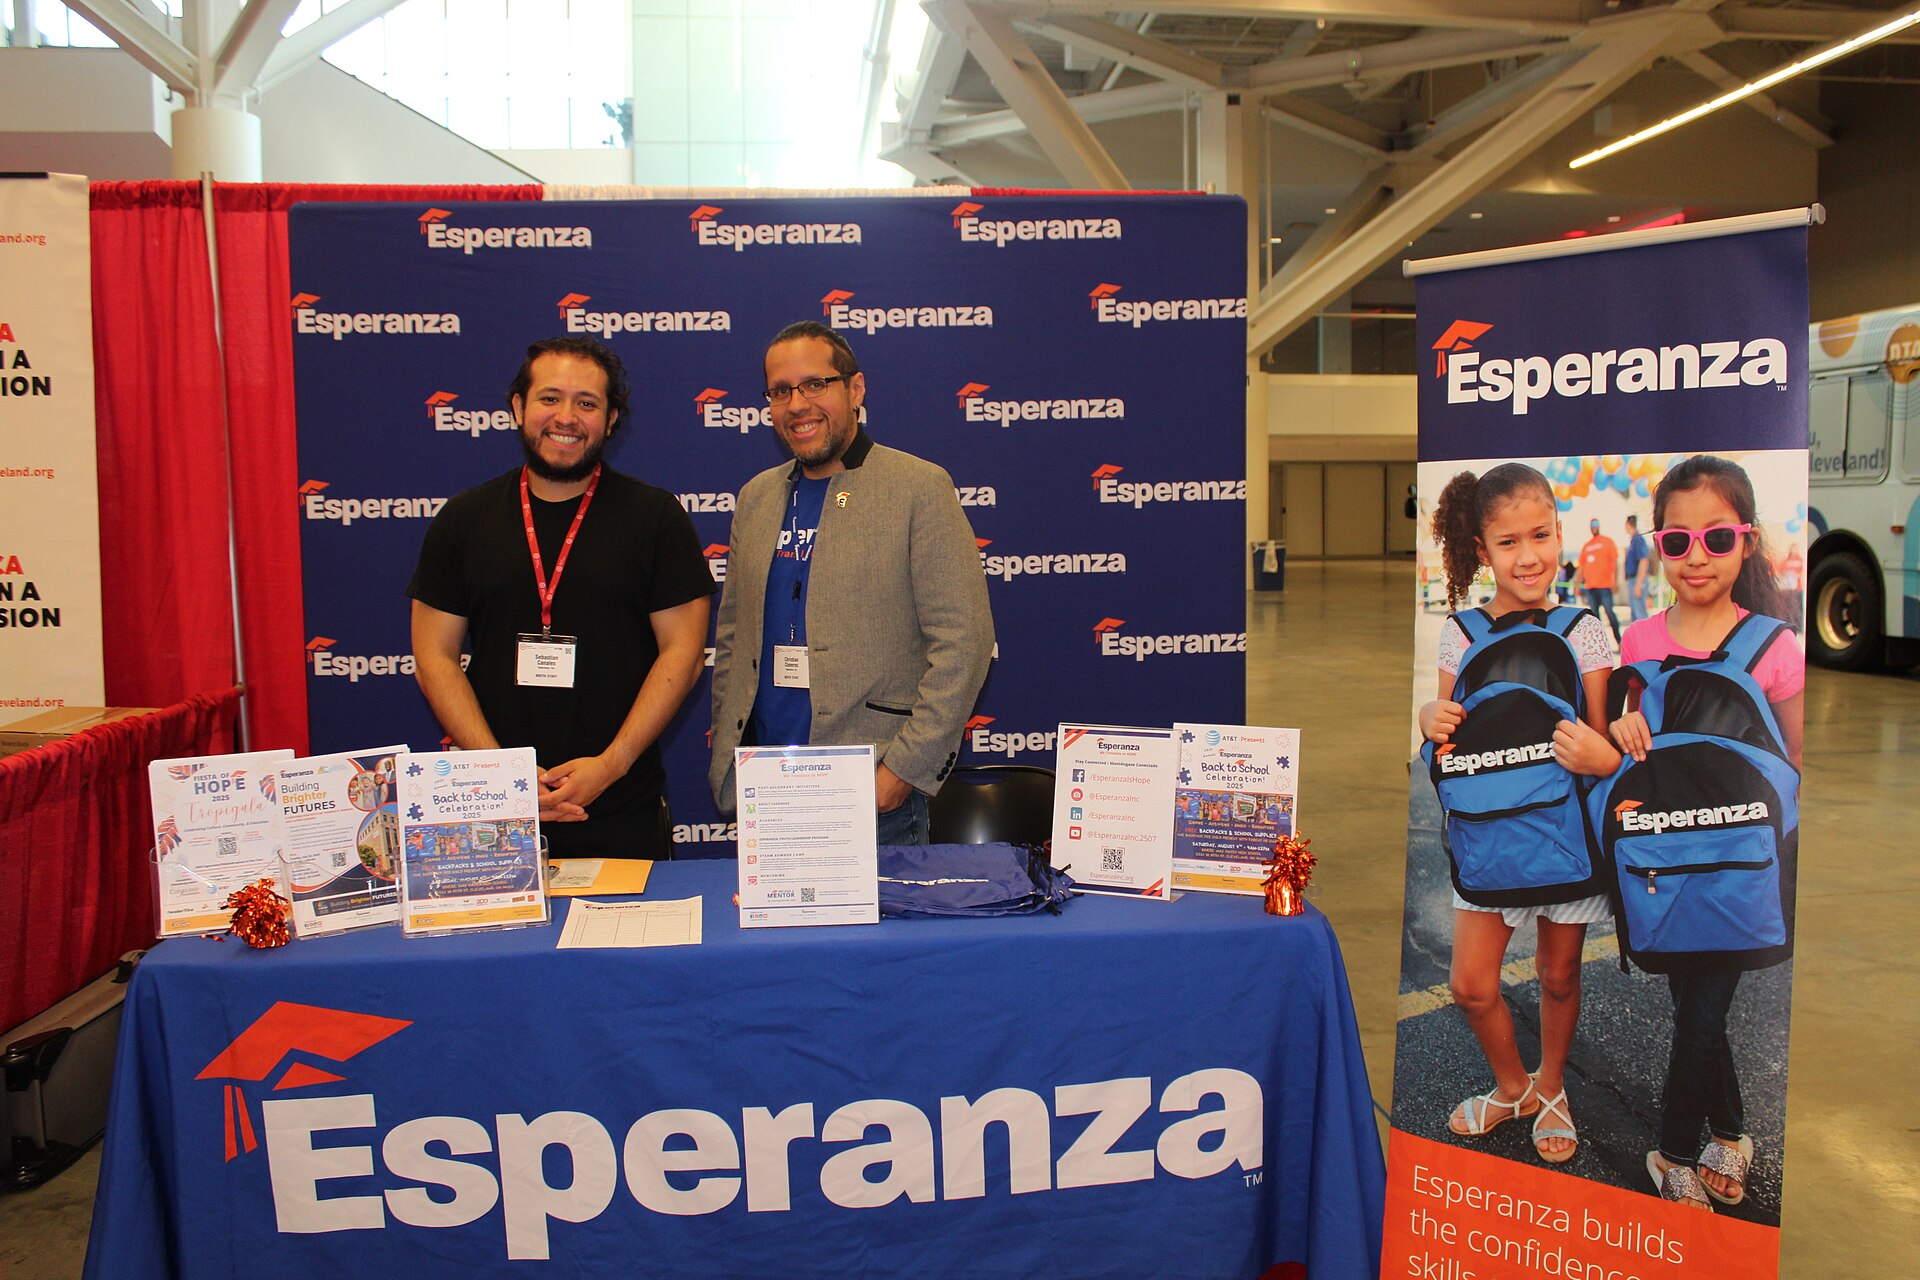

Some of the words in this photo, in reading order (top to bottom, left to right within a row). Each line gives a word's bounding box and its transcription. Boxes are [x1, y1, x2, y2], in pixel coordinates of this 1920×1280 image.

[427, 223, 592, 254] Esperanza
[698, 220, 862, 252] Esperanza
[960, 216, 1122, 247] Esperanza
[296, 308, 460, 340] Esperanza
[566, 307, 731, 339] Esperanza
[830, 303, 993, 335] Esperanza
[1098, 298, 1248, 329] Esperanza
[1448, 337, 1787, 416] Esperanza
[434, 406, 518, 437] Esper
[966, 397, 1124, 427] Esperanza
[1809, 448, 1886, 472] leveand!
[306, 495, 447, 526] Esperanz
[314, 652, 416, 682] Espera
[972, 729, 1057, 758] Esper
[1098, 741, 1140, 752] Esperanza
[280, 770, 314, 779] Esperanza
[781, 764, 831, 773] Esperanza
[1090, 774, 1151, 784] /EsperanzaIsHope
[1202, 762, 1224, 772] Back
[1227, 763, 1236, 772] to
[1240, 764, 1270, 775] School
[1206, 774, 1265, 783] Celebration!
[194, 777, 246, 794] HOPE
[282, 782, 319, 793] Building
[452, 780, 488, 788] Esperanza
[283, 791, 327, 804] Brighter
[284, 801, 336, 815] FUTURES
[432, 792, 459, 805] Back
[462, 793, 472, 802] to
[474, 790, 508, 800] School
[439, 803, 504, 813] Celebration!
[1089, 792, 1140, 803] @EsperanzaInc
[1088, 812, 1136, 822] /EsperanzaInc
[1622, 801, 1769, 834] Esperanza
[262, 1067, 1263, 1260] Esperanza
[1243, 1173, 1264, 1188] TM
[1410, 1208, 1457, 1245] the
[1413, 1165, 1570, 1233] Esperanza
[1583, 1209, 1684, 1264] builds
